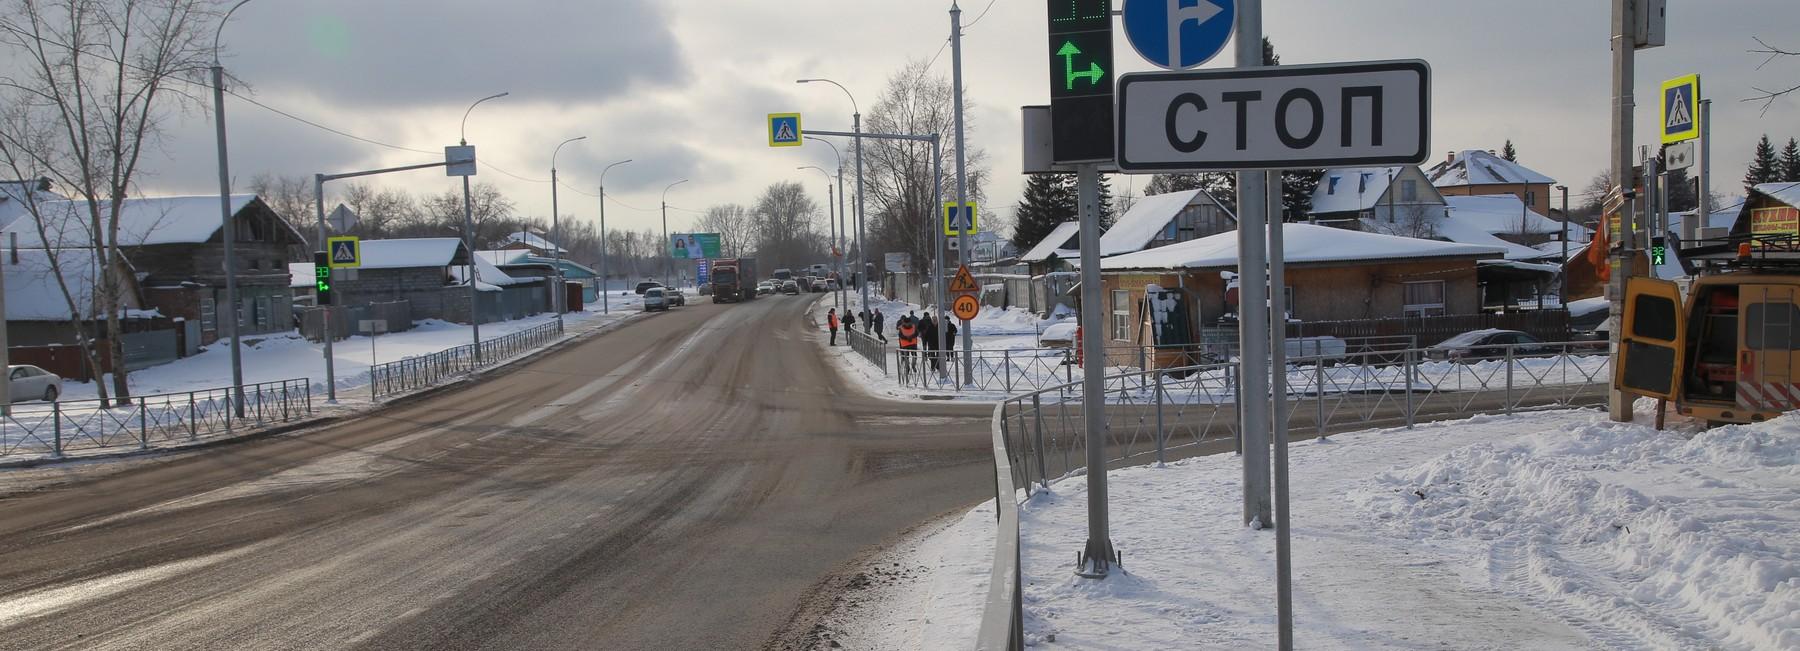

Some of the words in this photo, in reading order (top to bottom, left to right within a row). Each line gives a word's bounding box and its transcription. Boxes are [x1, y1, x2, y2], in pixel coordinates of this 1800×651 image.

[1165, 86, 1383, 153] СТОП
[1652, 246, 1665, 256] 32
[315, 267, 329, 278] 33
[959, 302, 973, 313] 40
